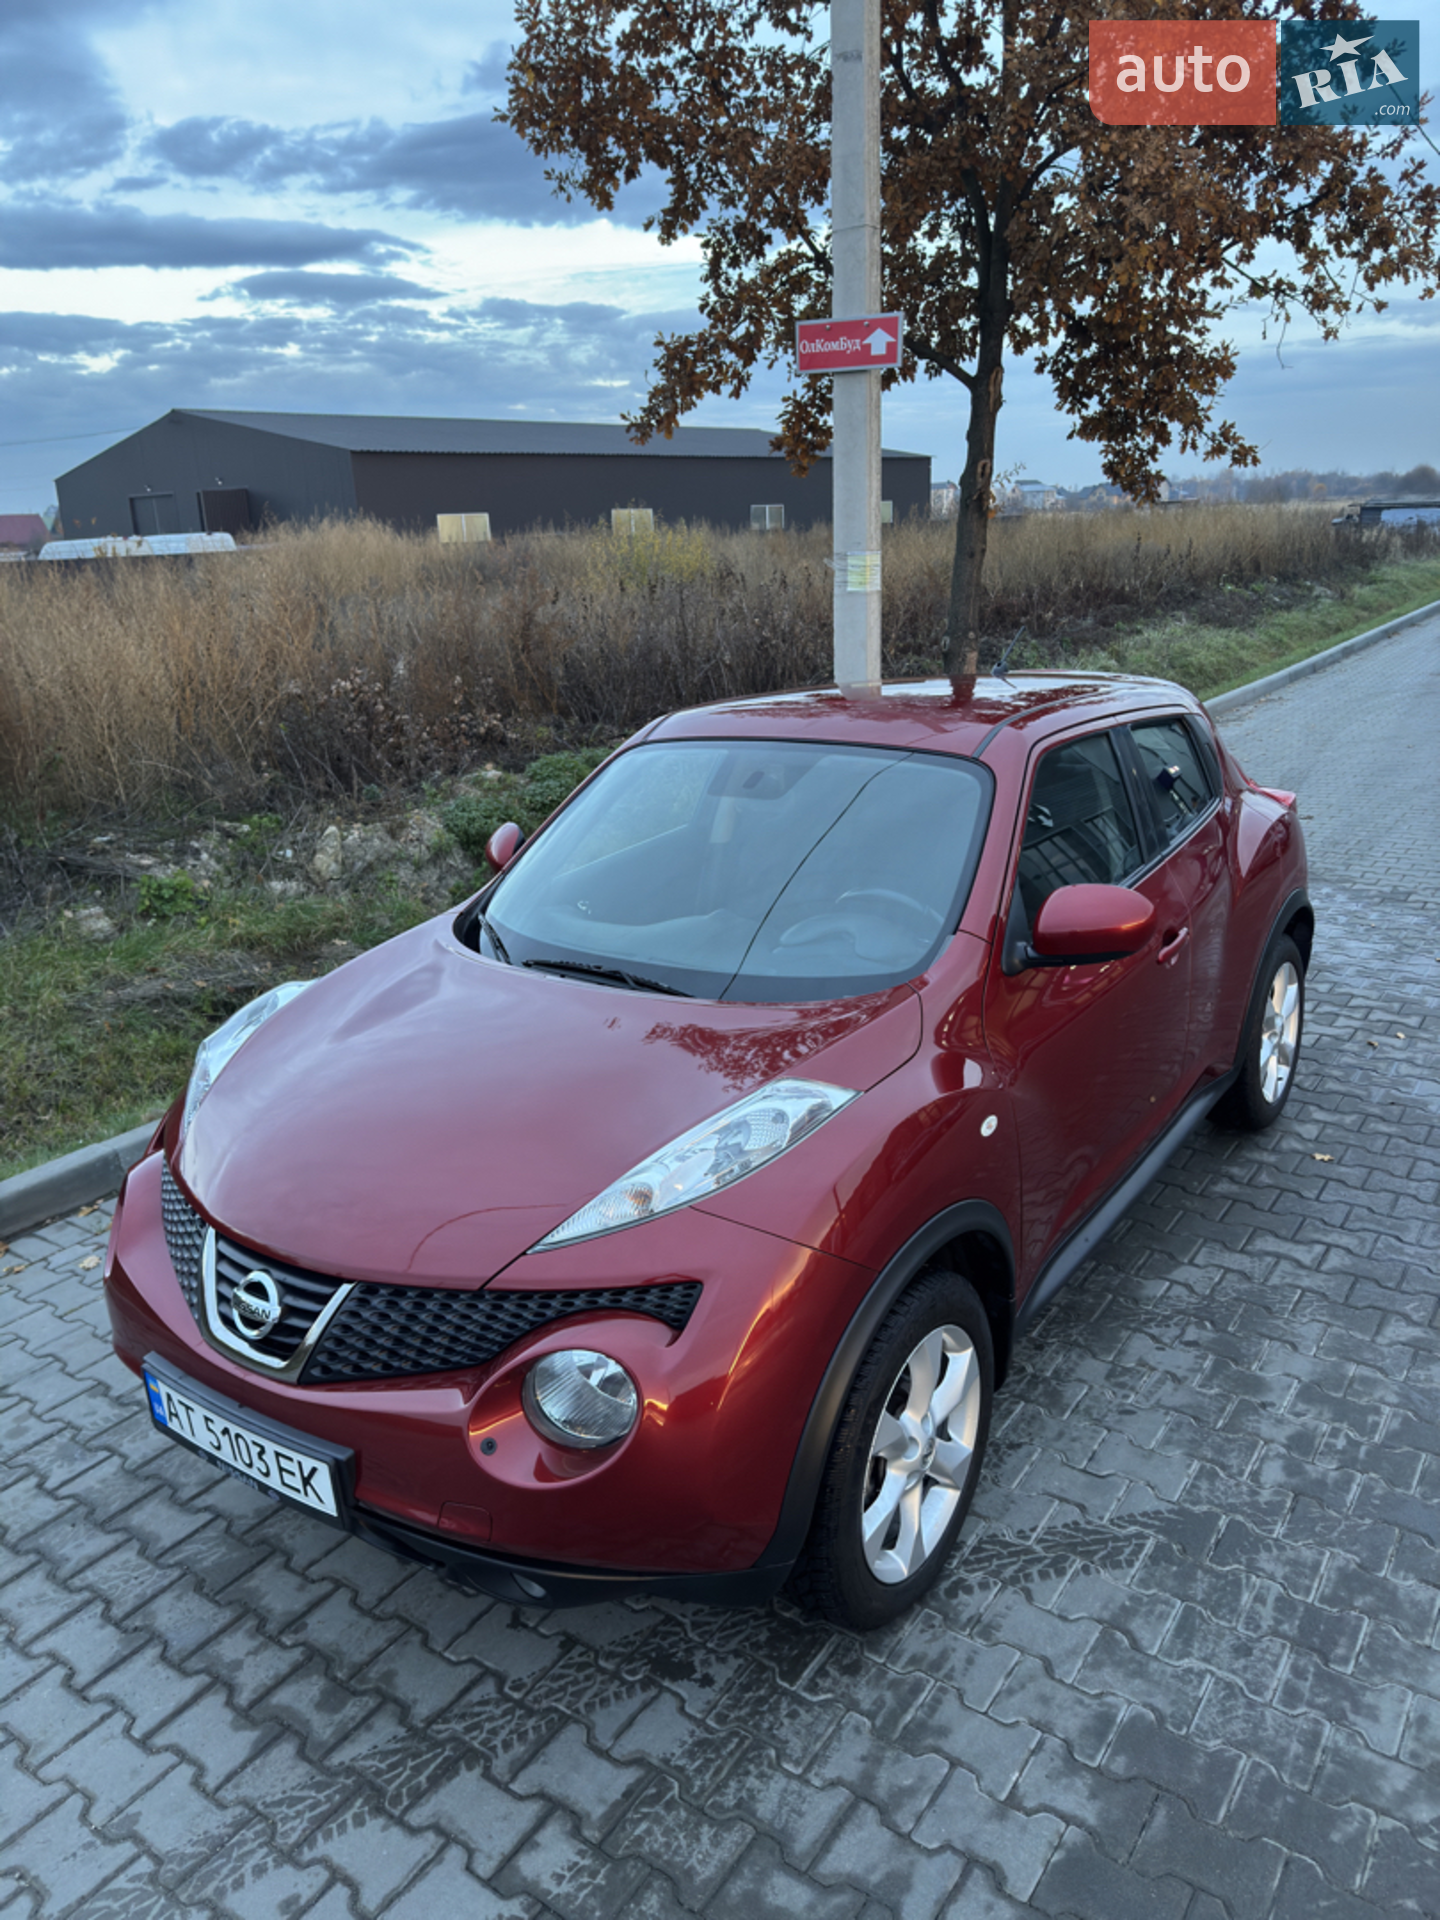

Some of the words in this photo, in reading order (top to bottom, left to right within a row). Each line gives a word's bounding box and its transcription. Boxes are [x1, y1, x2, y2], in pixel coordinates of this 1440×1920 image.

[800, 336, 861, 354] ОлКомБуд
[166, 1392, 195, 1438] AT
[203, 1414, 271, 1478] 5103
[273, 1450, 325, 1505] EK
